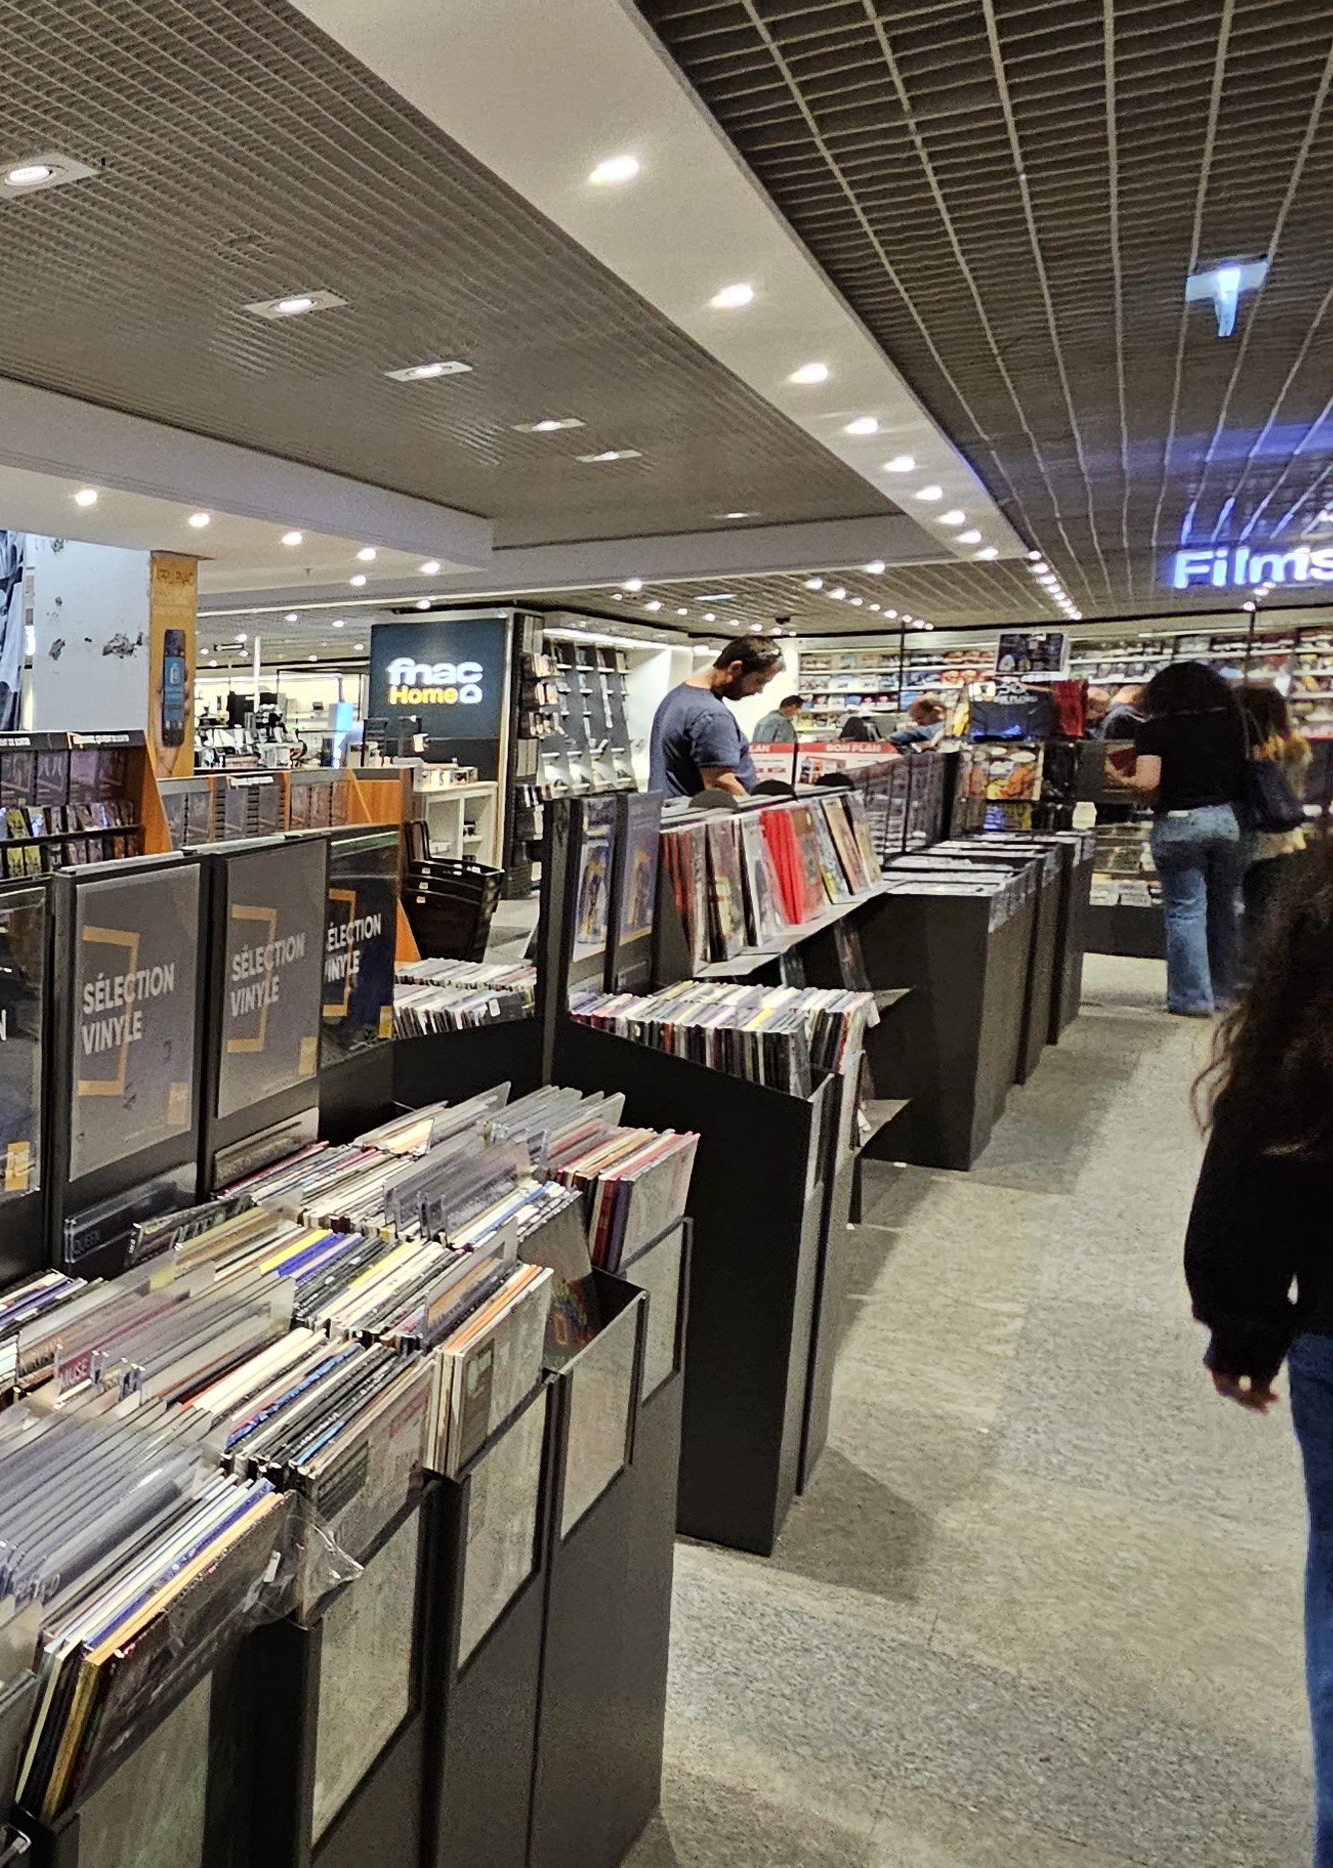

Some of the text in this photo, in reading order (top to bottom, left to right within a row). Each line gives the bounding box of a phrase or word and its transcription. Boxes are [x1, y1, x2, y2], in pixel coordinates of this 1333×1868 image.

[1173, 546, 1333, 589] Films
[386, 657, 483, 685] fnac
[389, 684, 458, 705] Home
[826, 743, 881, 752] BON PLAN
[326, 912, 382, 952] ÉLECTION
[231, 932, 306, 983] SÉLECTION
[82, 962, 175, 1016] SÉLECTION
[229, 973, 280, 1018] VINYLE
[80, 1010, 143, 1056] VINYLE
